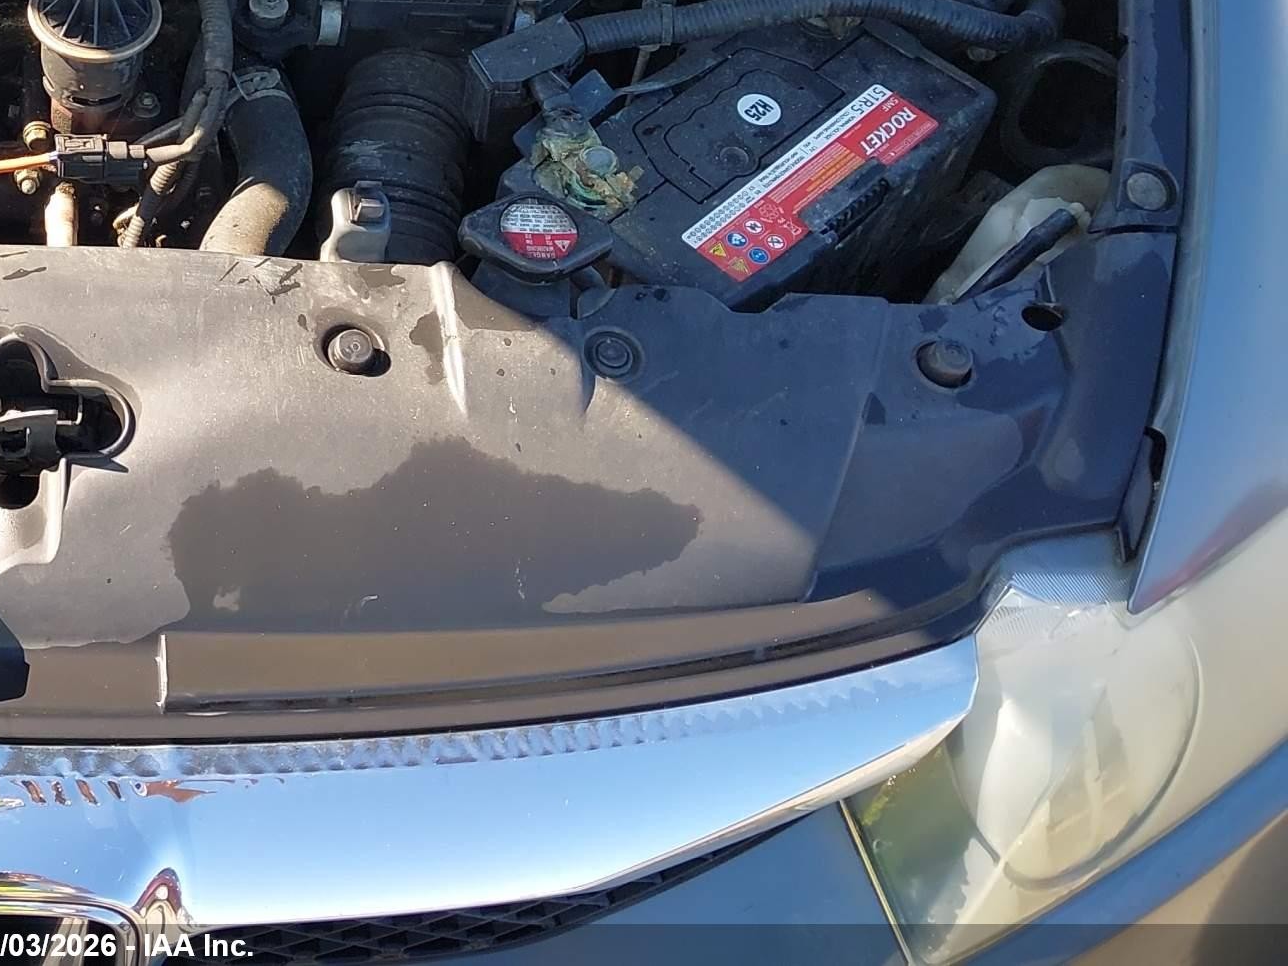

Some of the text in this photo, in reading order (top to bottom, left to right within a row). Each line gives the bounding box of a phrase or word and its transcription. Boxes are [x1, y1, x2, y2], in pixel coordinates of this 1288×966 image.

[743, 99, 774, 122] H25
[850, 87, 887, 115] 51R-5
[881, 96, 899, 113] SMF
[860, 106, 917, 156] ROCKET
